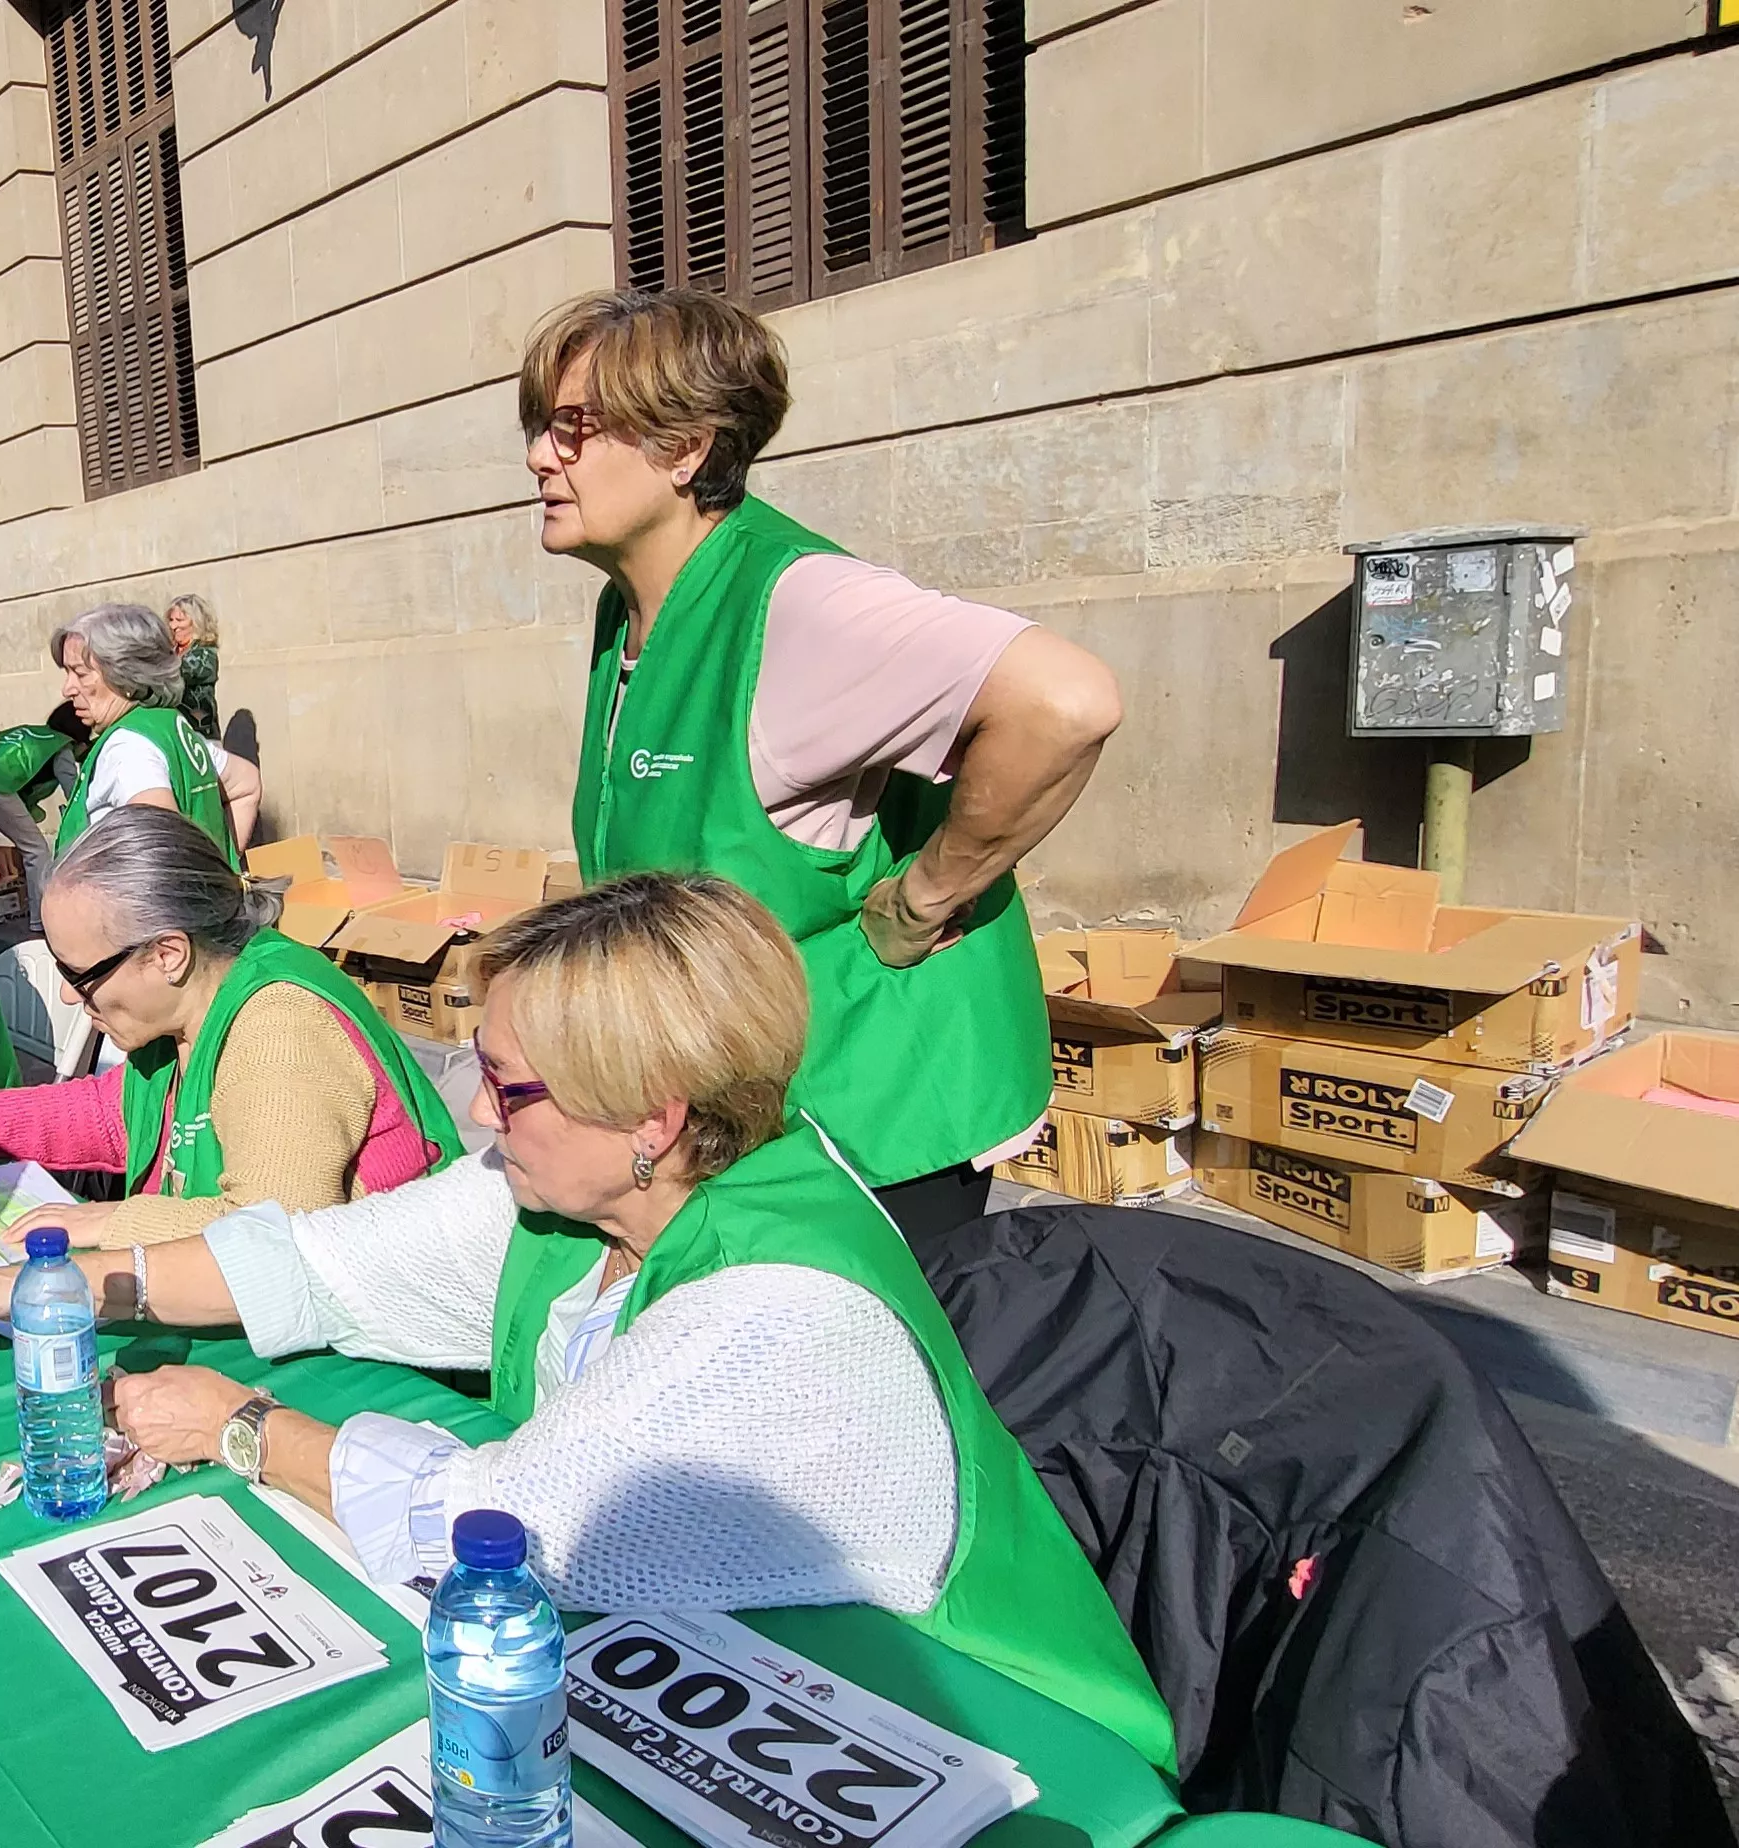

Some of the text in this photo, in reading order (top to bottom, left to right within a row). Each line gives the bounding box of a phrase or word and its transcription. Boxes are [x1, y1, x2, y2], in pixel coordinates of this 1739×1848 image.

[484, 850, 503, 872] S
[1314, 1075, 1408, 1112] ROLY
[1571, 1269, 1589, 1288] S
[67, 1557, 195, 1702] CONTRA EL CÁNCER
[86, 1610, 129, 1657] HUESCA
[98, 1544, 299, 1688] 2107
[445, 1737, 469, 1761] 50cl
[590, 1636, 926, 1823] 2200
[630, 1737, 719, 1796] HUESCA
[680, 1742, 710, 1767] EL
[704, 1759, 844, 1846] CONTRA
